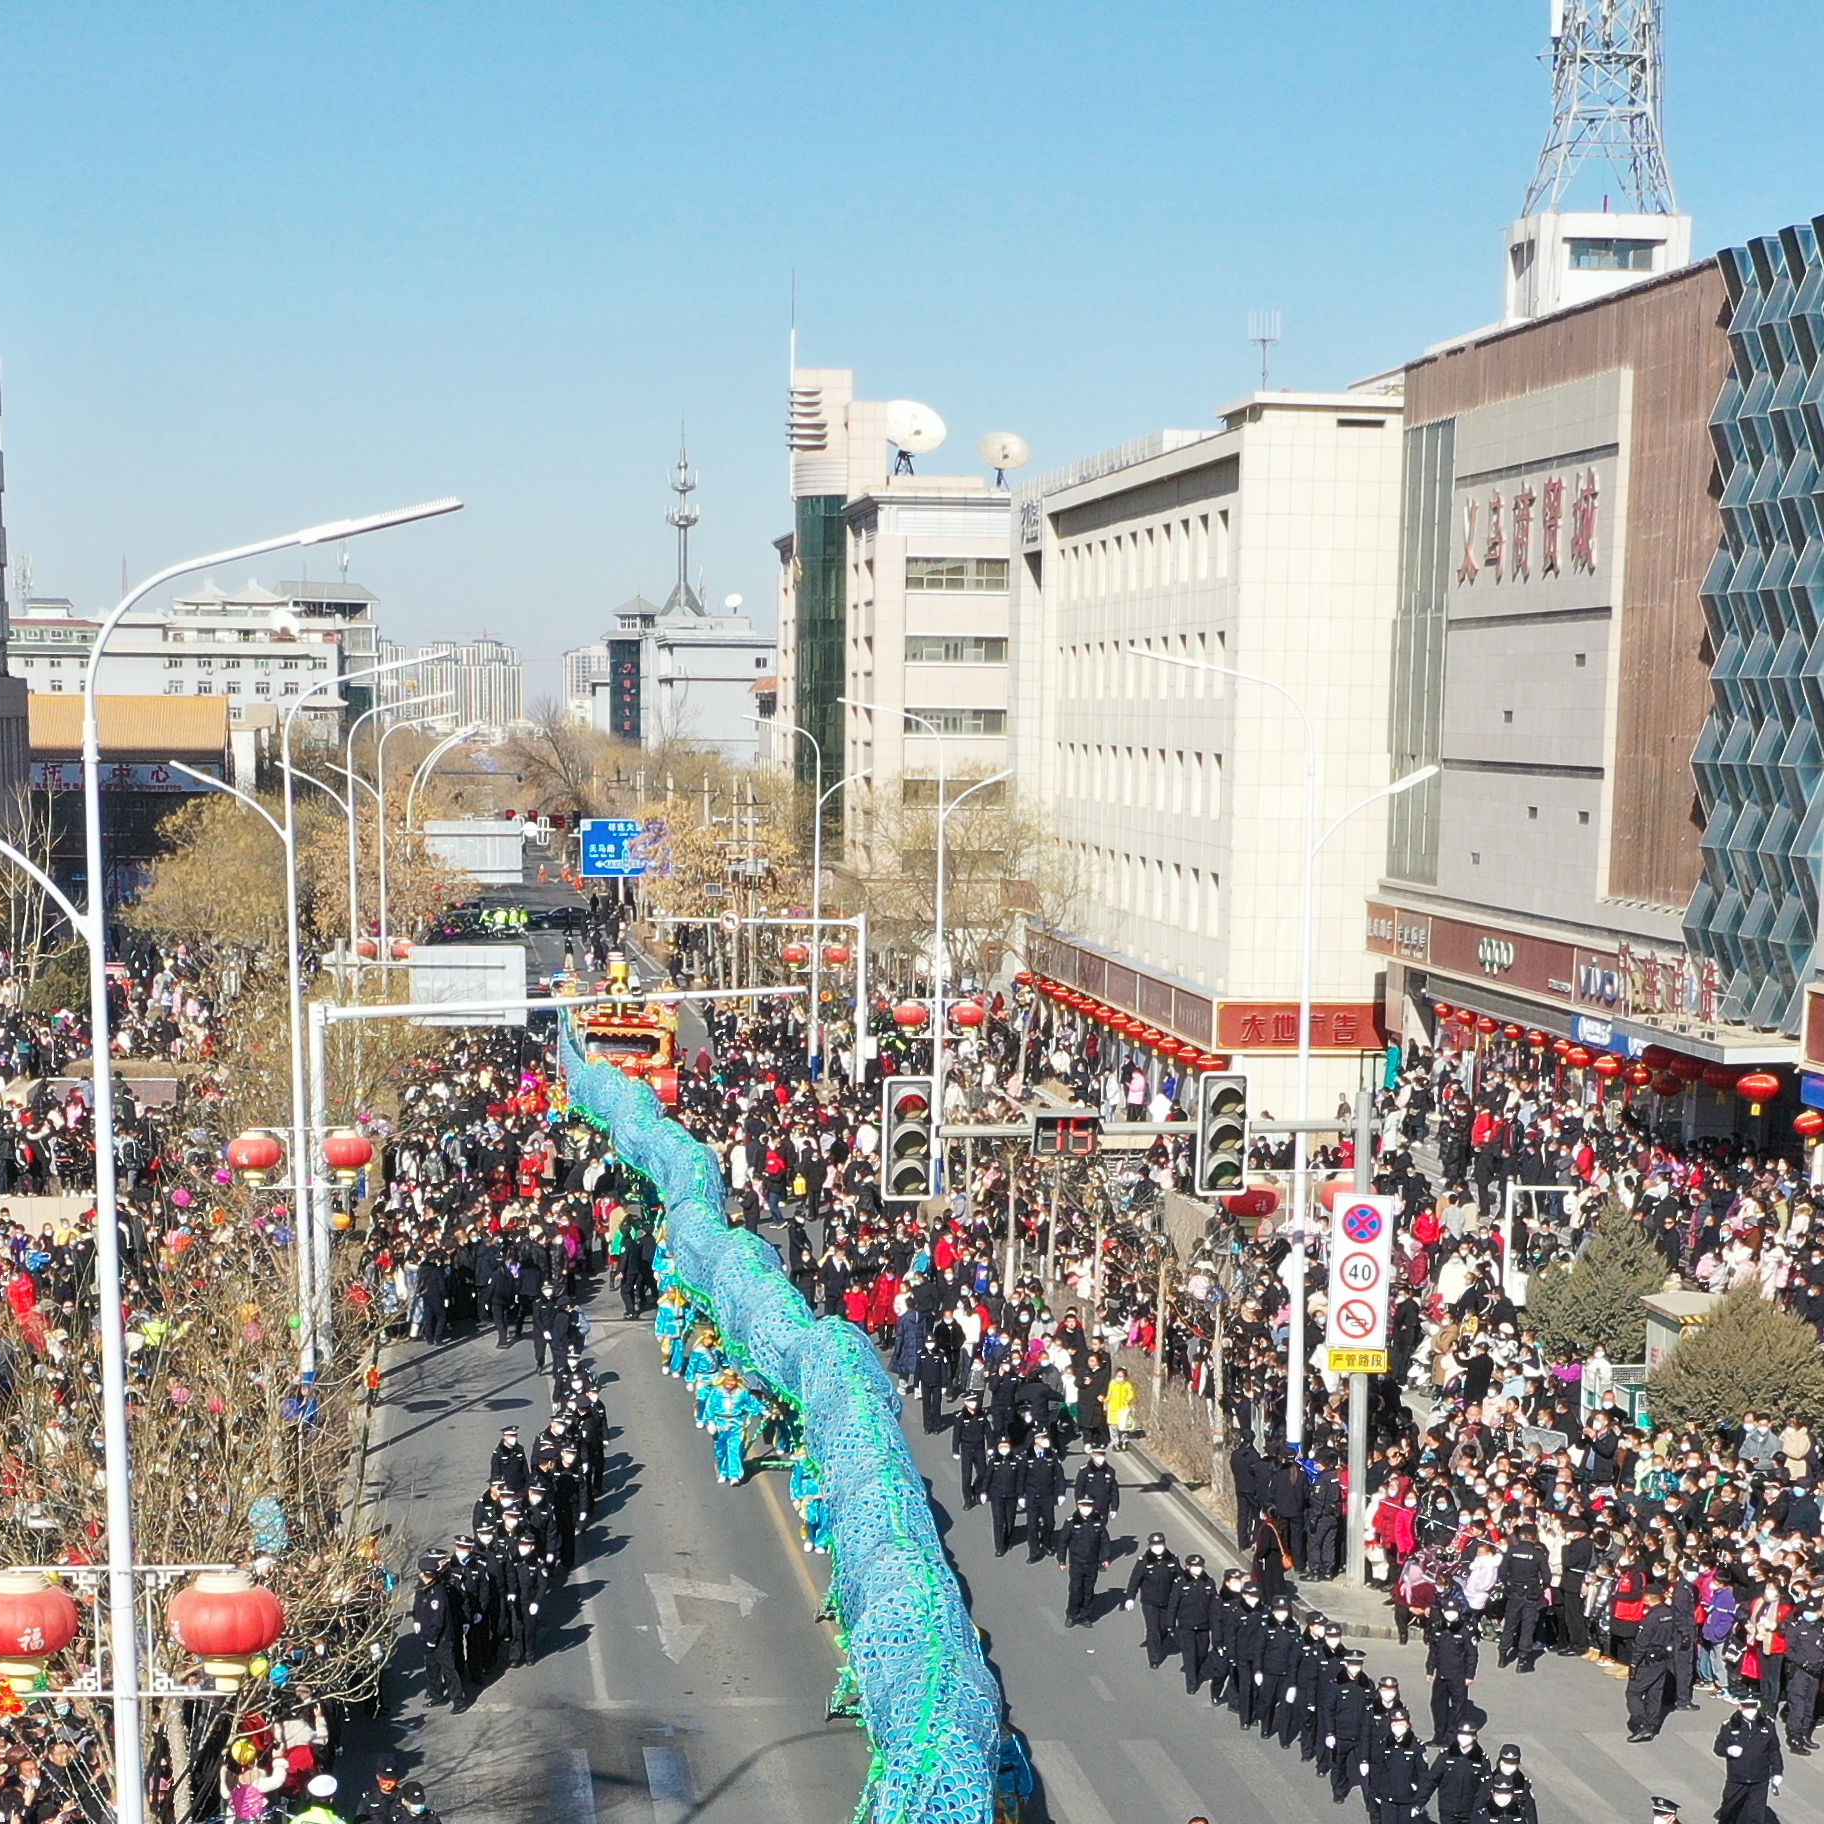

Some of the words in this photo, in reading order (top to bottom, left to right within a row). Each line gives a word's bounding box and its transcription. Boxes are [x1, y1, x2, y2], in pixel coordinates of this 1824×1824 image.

[1579, 956, 1619, 1001] vivo
[1348, 1264, 1372, 1281] 40
[1332, 1353, 1383, 1367] 严管路段
[16, 1627, 46, 1651] 福
